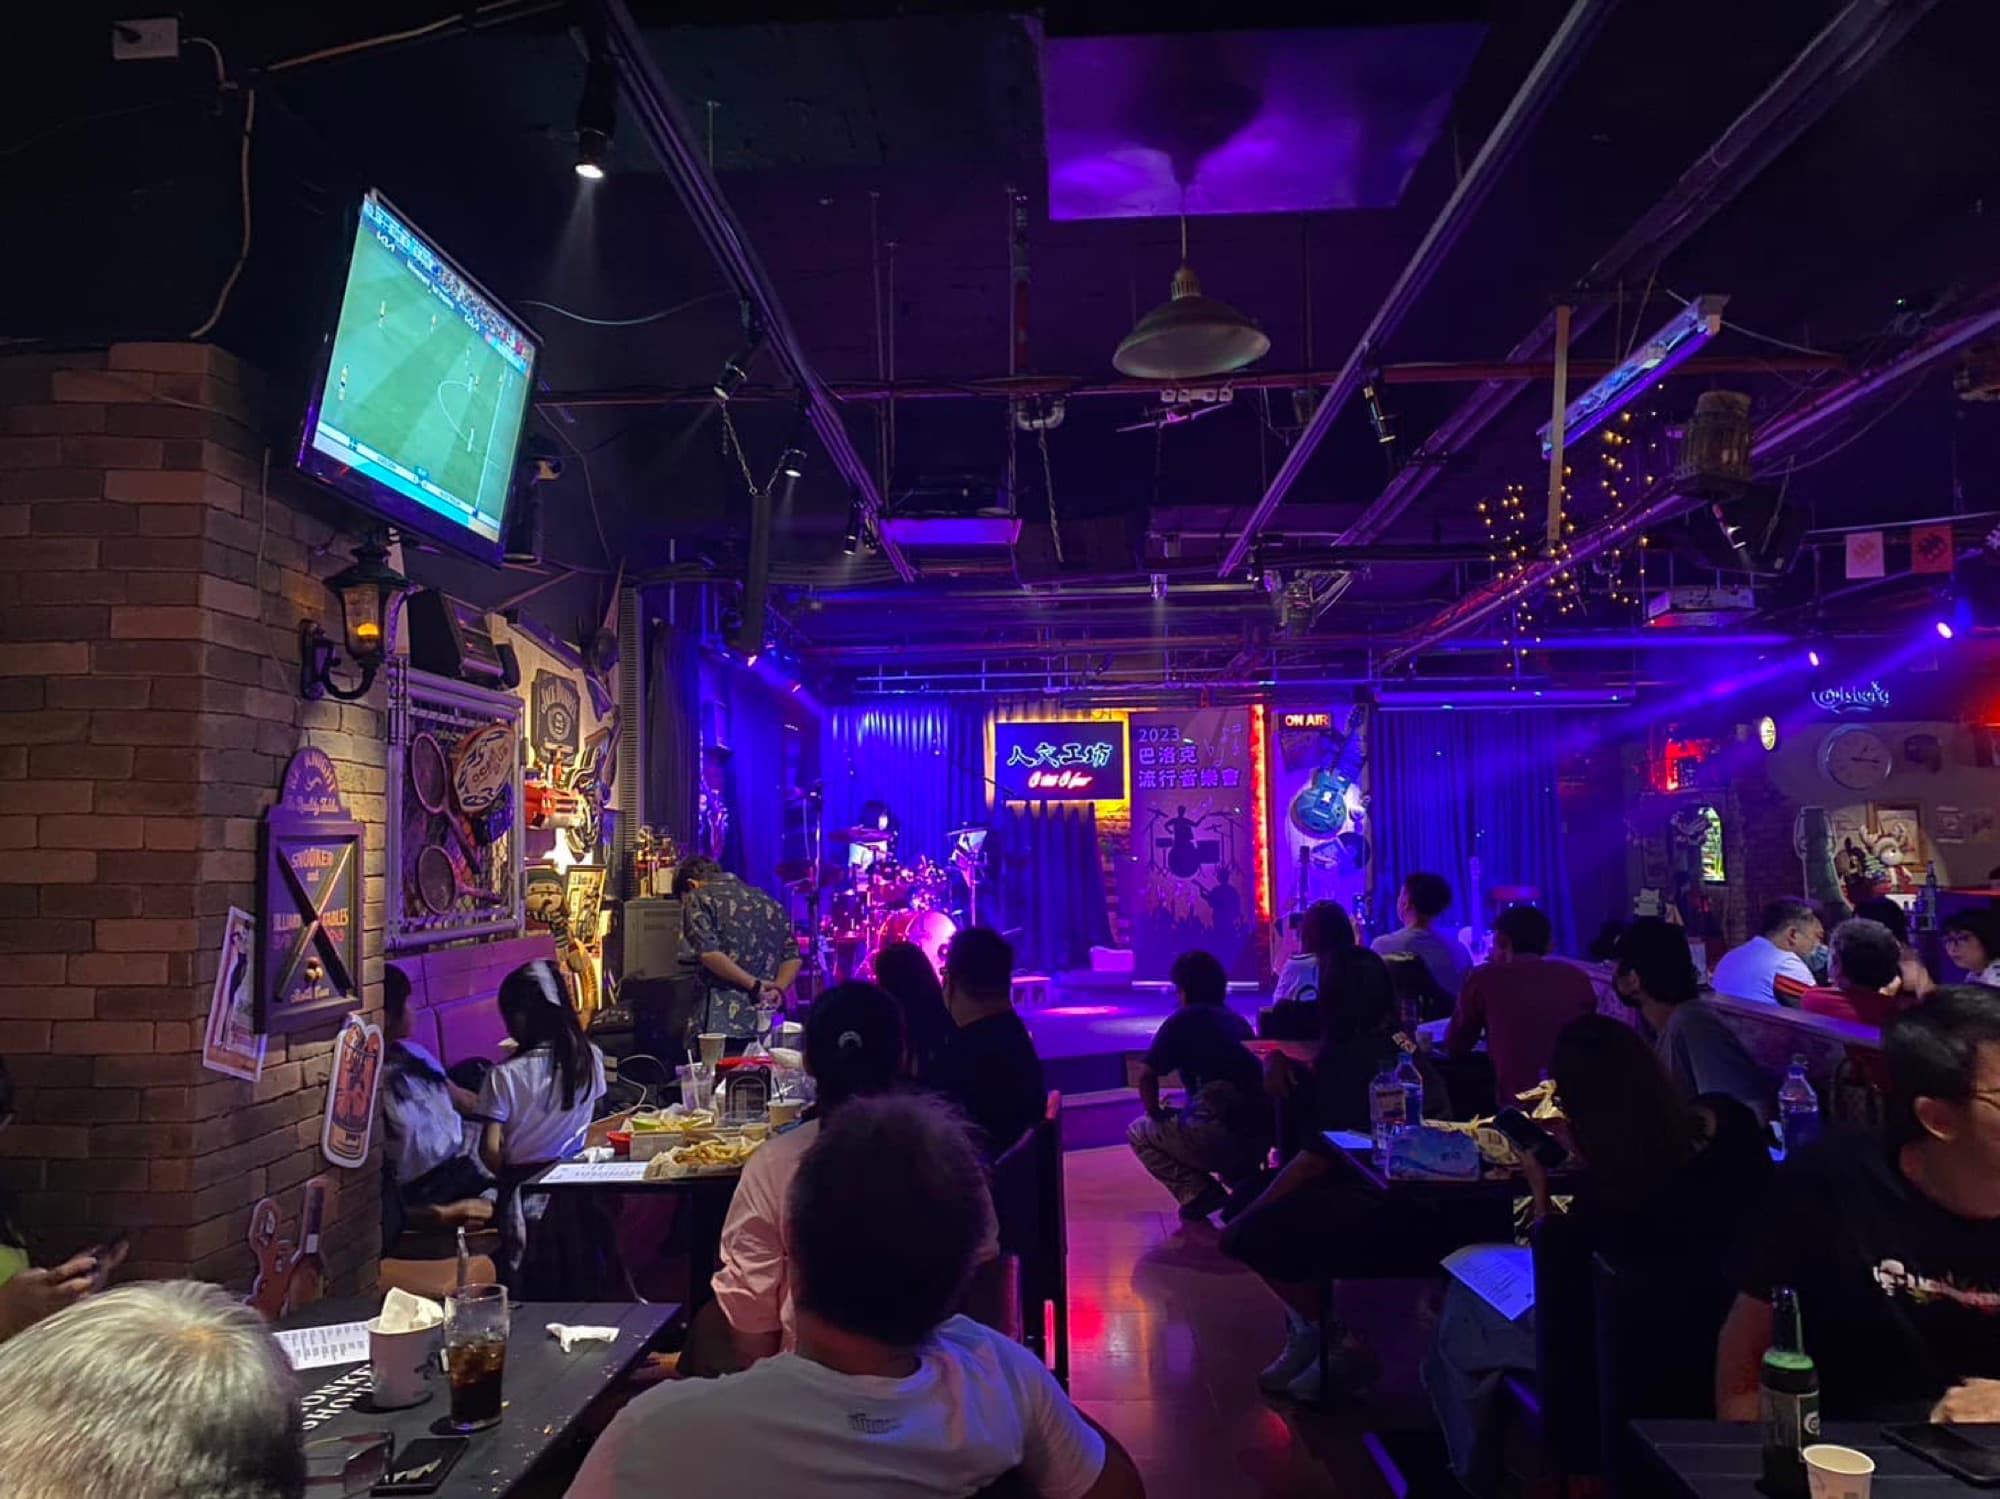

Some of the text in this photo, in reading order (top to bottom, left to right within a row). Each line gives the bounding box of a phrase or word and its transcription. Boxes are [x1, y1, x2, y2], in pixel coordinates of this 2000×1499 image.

[1285, 713, 1329, 726] ON AIR
[1138, 727, 1181, 743] 2023
[1006, 742, 1113, 768] 人文工坊
[1138, 745, 1198, 765] 巴洛克
[1138, 768, 1240, 788] 流行音樂會
